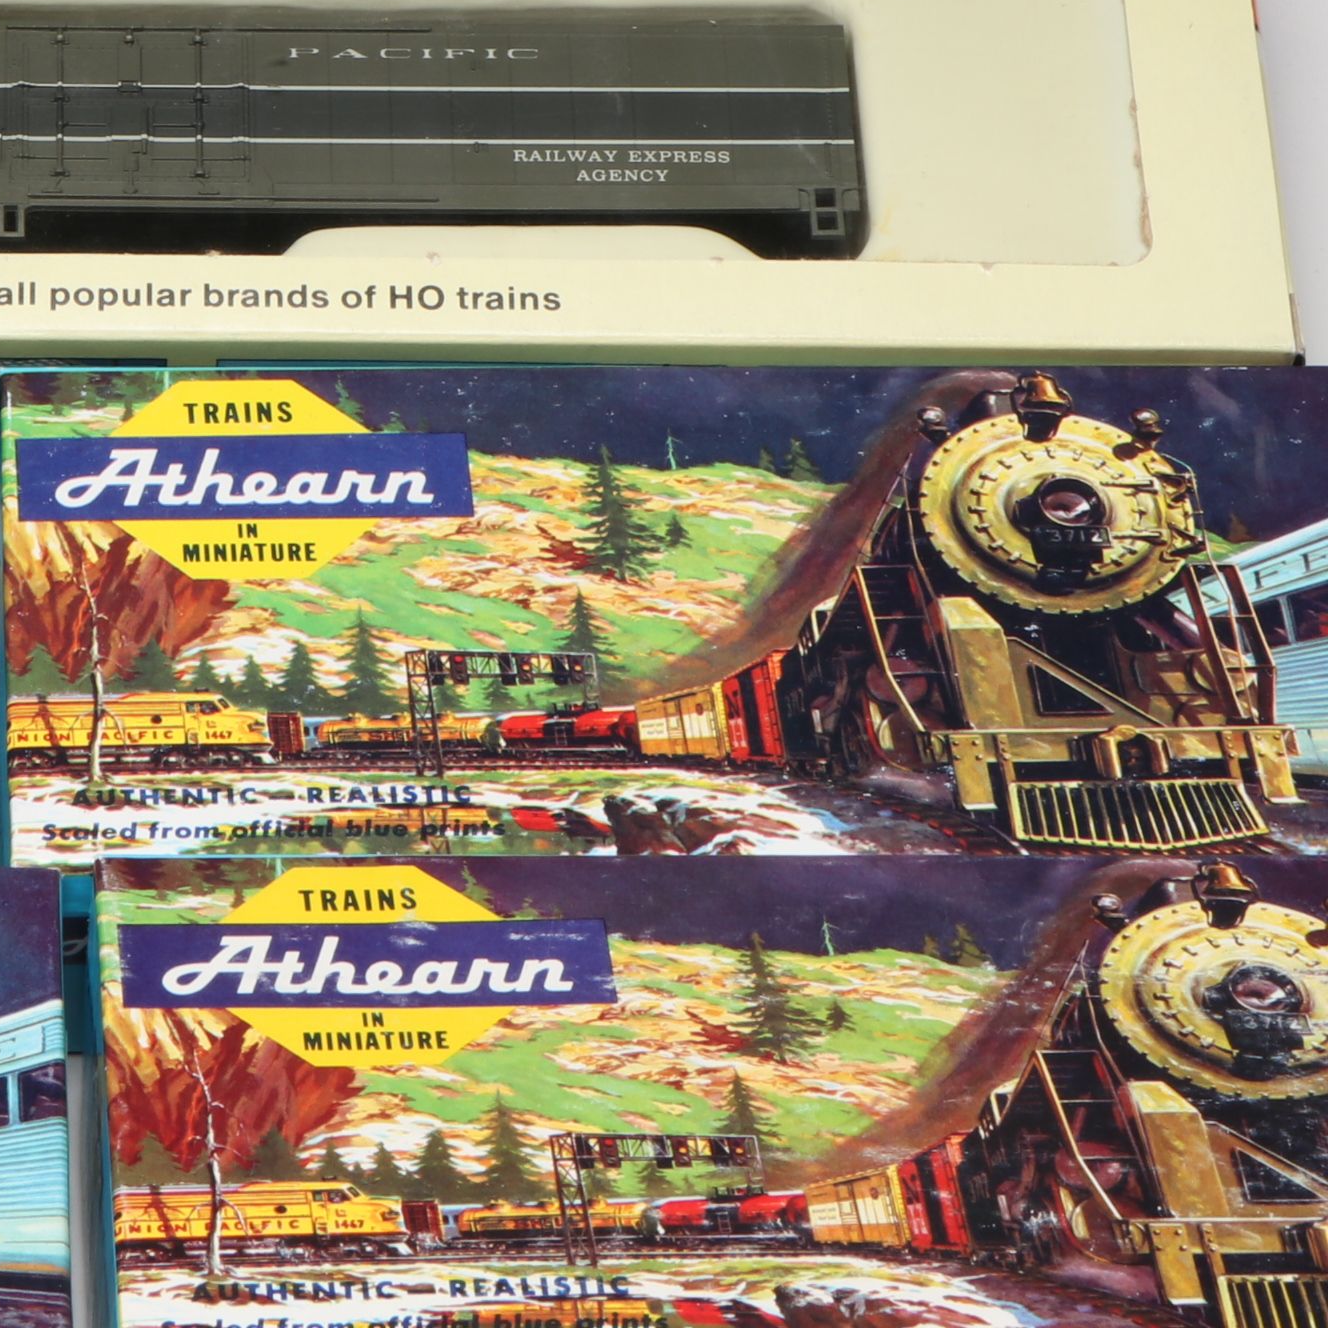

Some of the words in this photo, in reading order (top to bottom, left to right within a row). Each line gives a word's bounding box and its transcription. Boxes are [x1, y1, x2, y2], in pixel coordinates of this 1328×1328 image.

[287, 46, 541, 61] PACIFIC
[512, 148, 618, 164] RAILWAY
[627, 150, 731, 165] EXPRESS
[575, 168, 670, 183] AGENCY
[48, 282, 194, 313] popular
[202, 282, 330, 309] brands
[340, 284, 378, 310] of
[387, 285, 446, 311] HO
[454, 284, 562, 312] trains
[182, 401, 294, 425] TRAINS
[54, 447, 435, 508] Athearn
[236, 523, 259, 539] IN
[182, 542, 318, 563] MINIATURE
[205, 730, 233, 740] 1467
[72, 786, 257, 807] AUTHENTIC
[306, 784, 473, 805] REALISTIC
[41, 819, 138, 842] Scaled
[148, 820, 221, 841] from
[228, 818, 333, 841] official
[345, 819, 408, 838] blue
[420, 819, 506, 843] prints
[298, 886, 418, 913] TRAINS
[161, 935, 574, 996] Athearn
[361, 1012, 384, 1029] IN
[302, 1030, 450, 1052] MINIATURE
[334, 1219, 365, 1229] 1467
[192, 1280, 396, 1302] AUTHENTIC
[449, 1275, 632, 1298] REALISTIC
